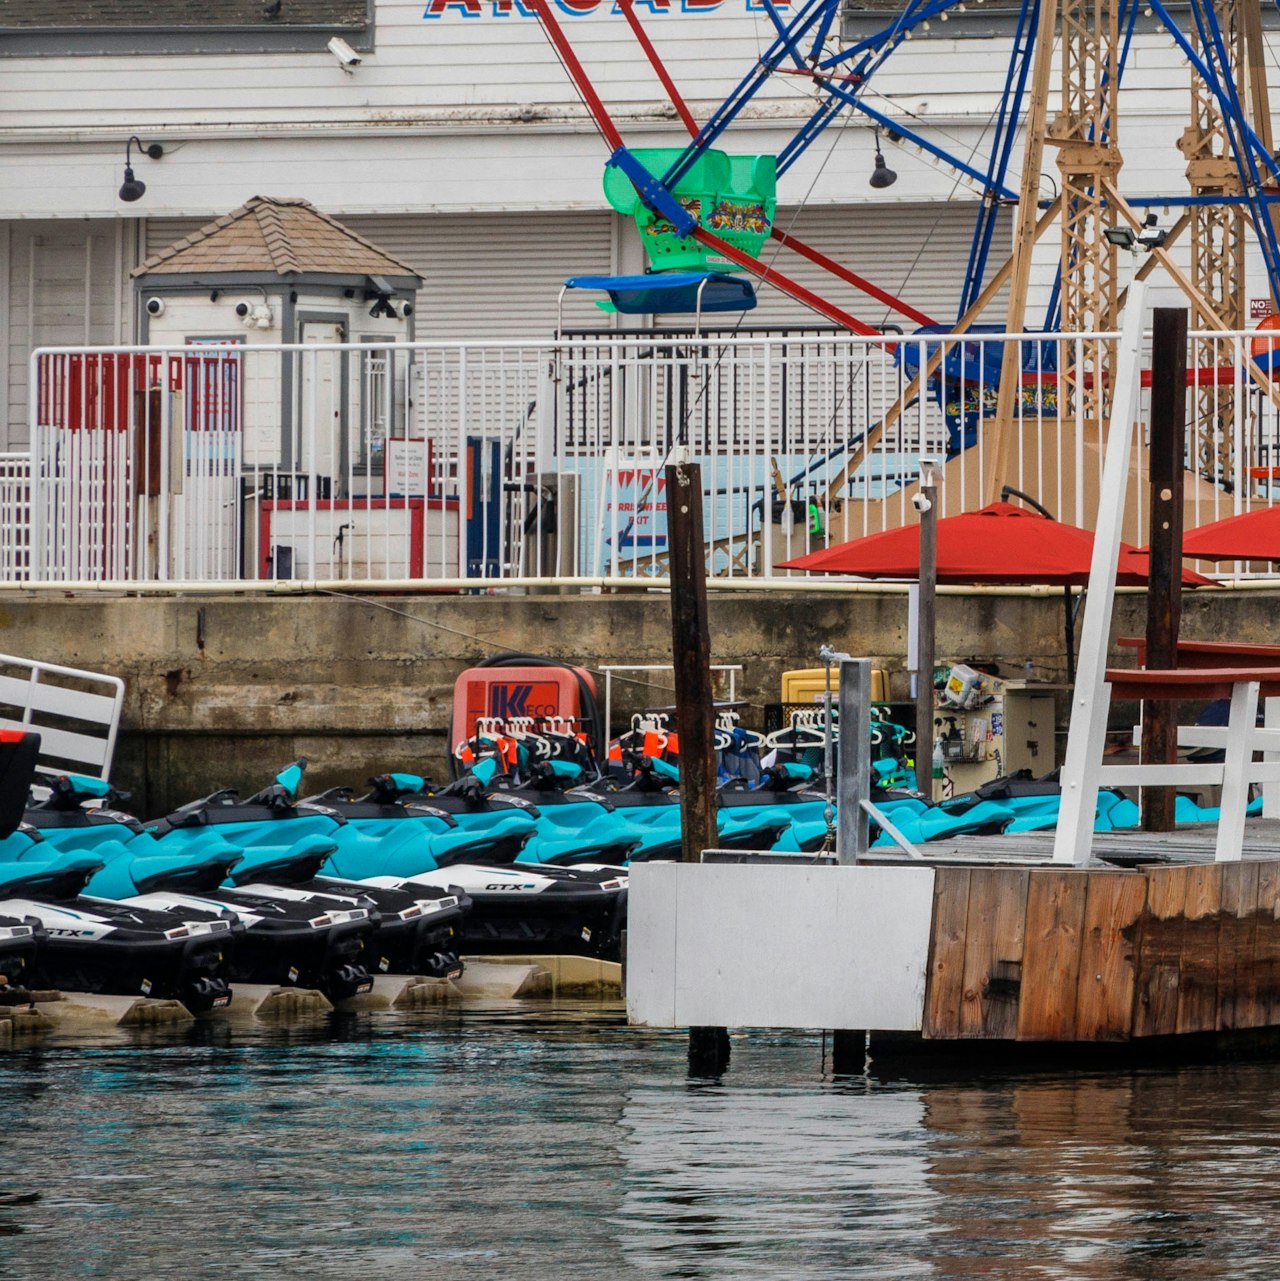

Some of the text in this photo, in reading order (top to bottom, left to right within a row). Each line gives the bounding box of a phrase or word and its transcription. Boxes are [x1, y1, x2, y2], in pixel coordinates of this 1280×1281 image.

[1251, 300, 1265, 309] NO
[526, 704, 556, 717] ECO
[485, 883, 524, 891] GTX
